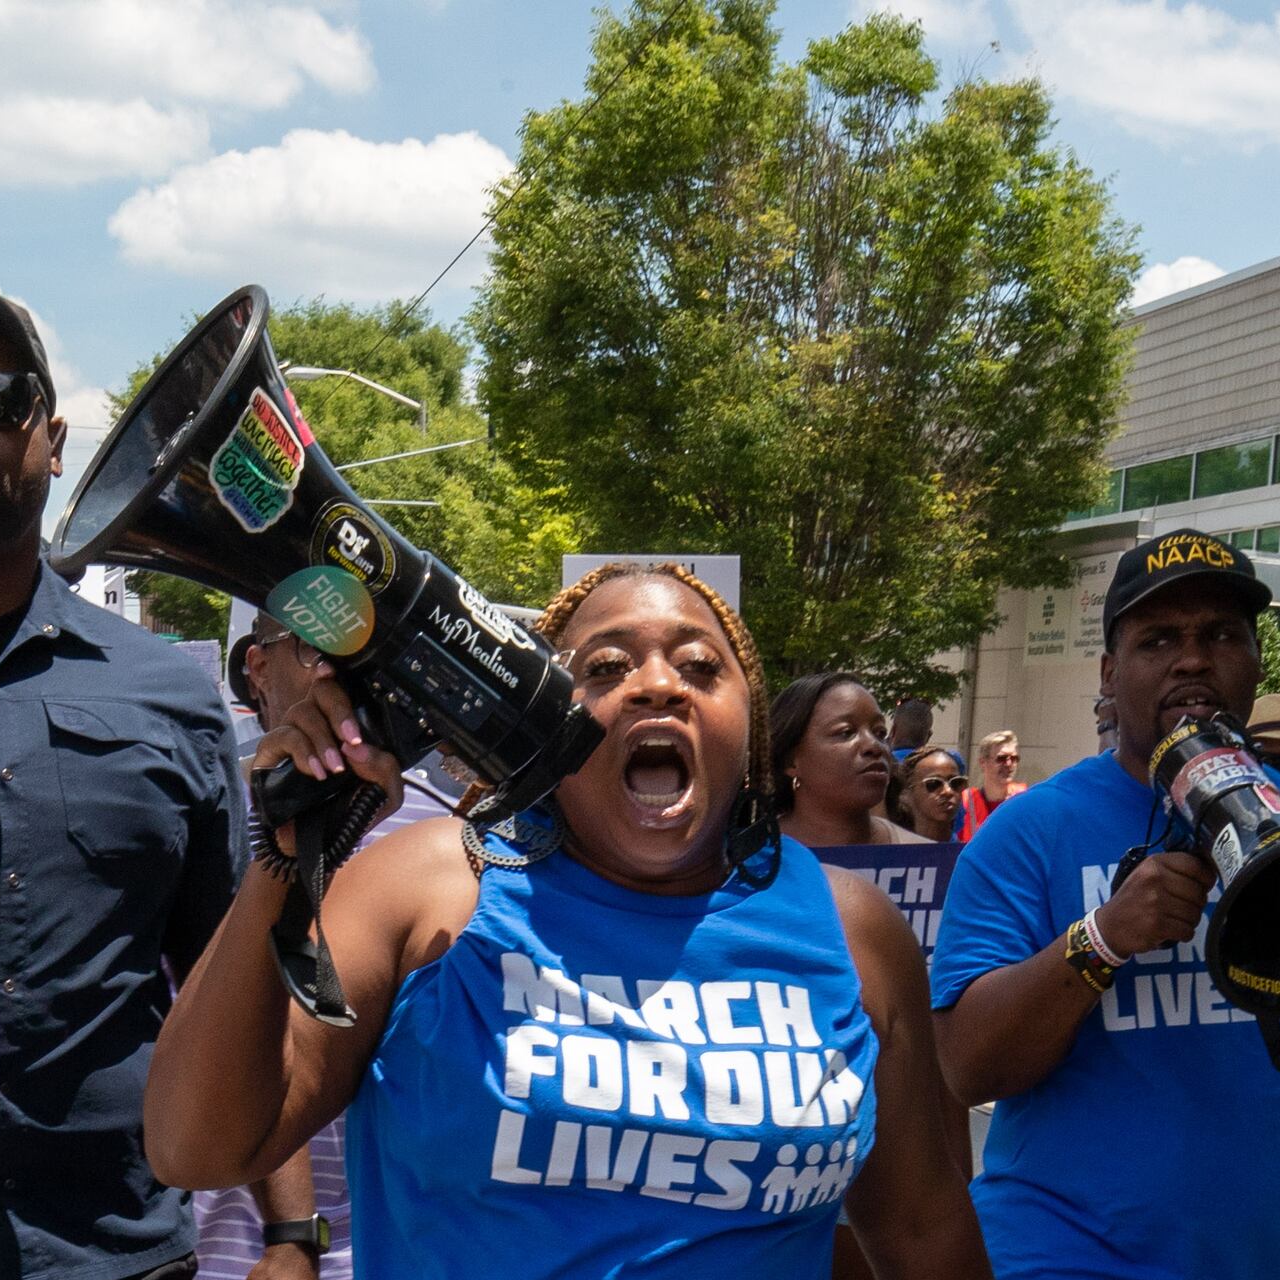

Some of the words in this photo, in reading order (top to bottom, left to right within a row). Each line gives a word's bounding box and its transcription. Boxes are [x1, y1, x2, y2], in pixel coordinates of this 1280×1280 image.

[1146, 543, 1235, 574] NAACP
[282, 596, 339, 646] VOTE
[306, 574, 368, 634] FIGHT
[428, 604, 520, 689] MyMealivos
[1187, 754, 1238, 781] STAY
[499, 952, 823, 1048] MARCH
[503, 1026, 690, 1121] FOR
[490, 1109, 760, 1211] LIVES
